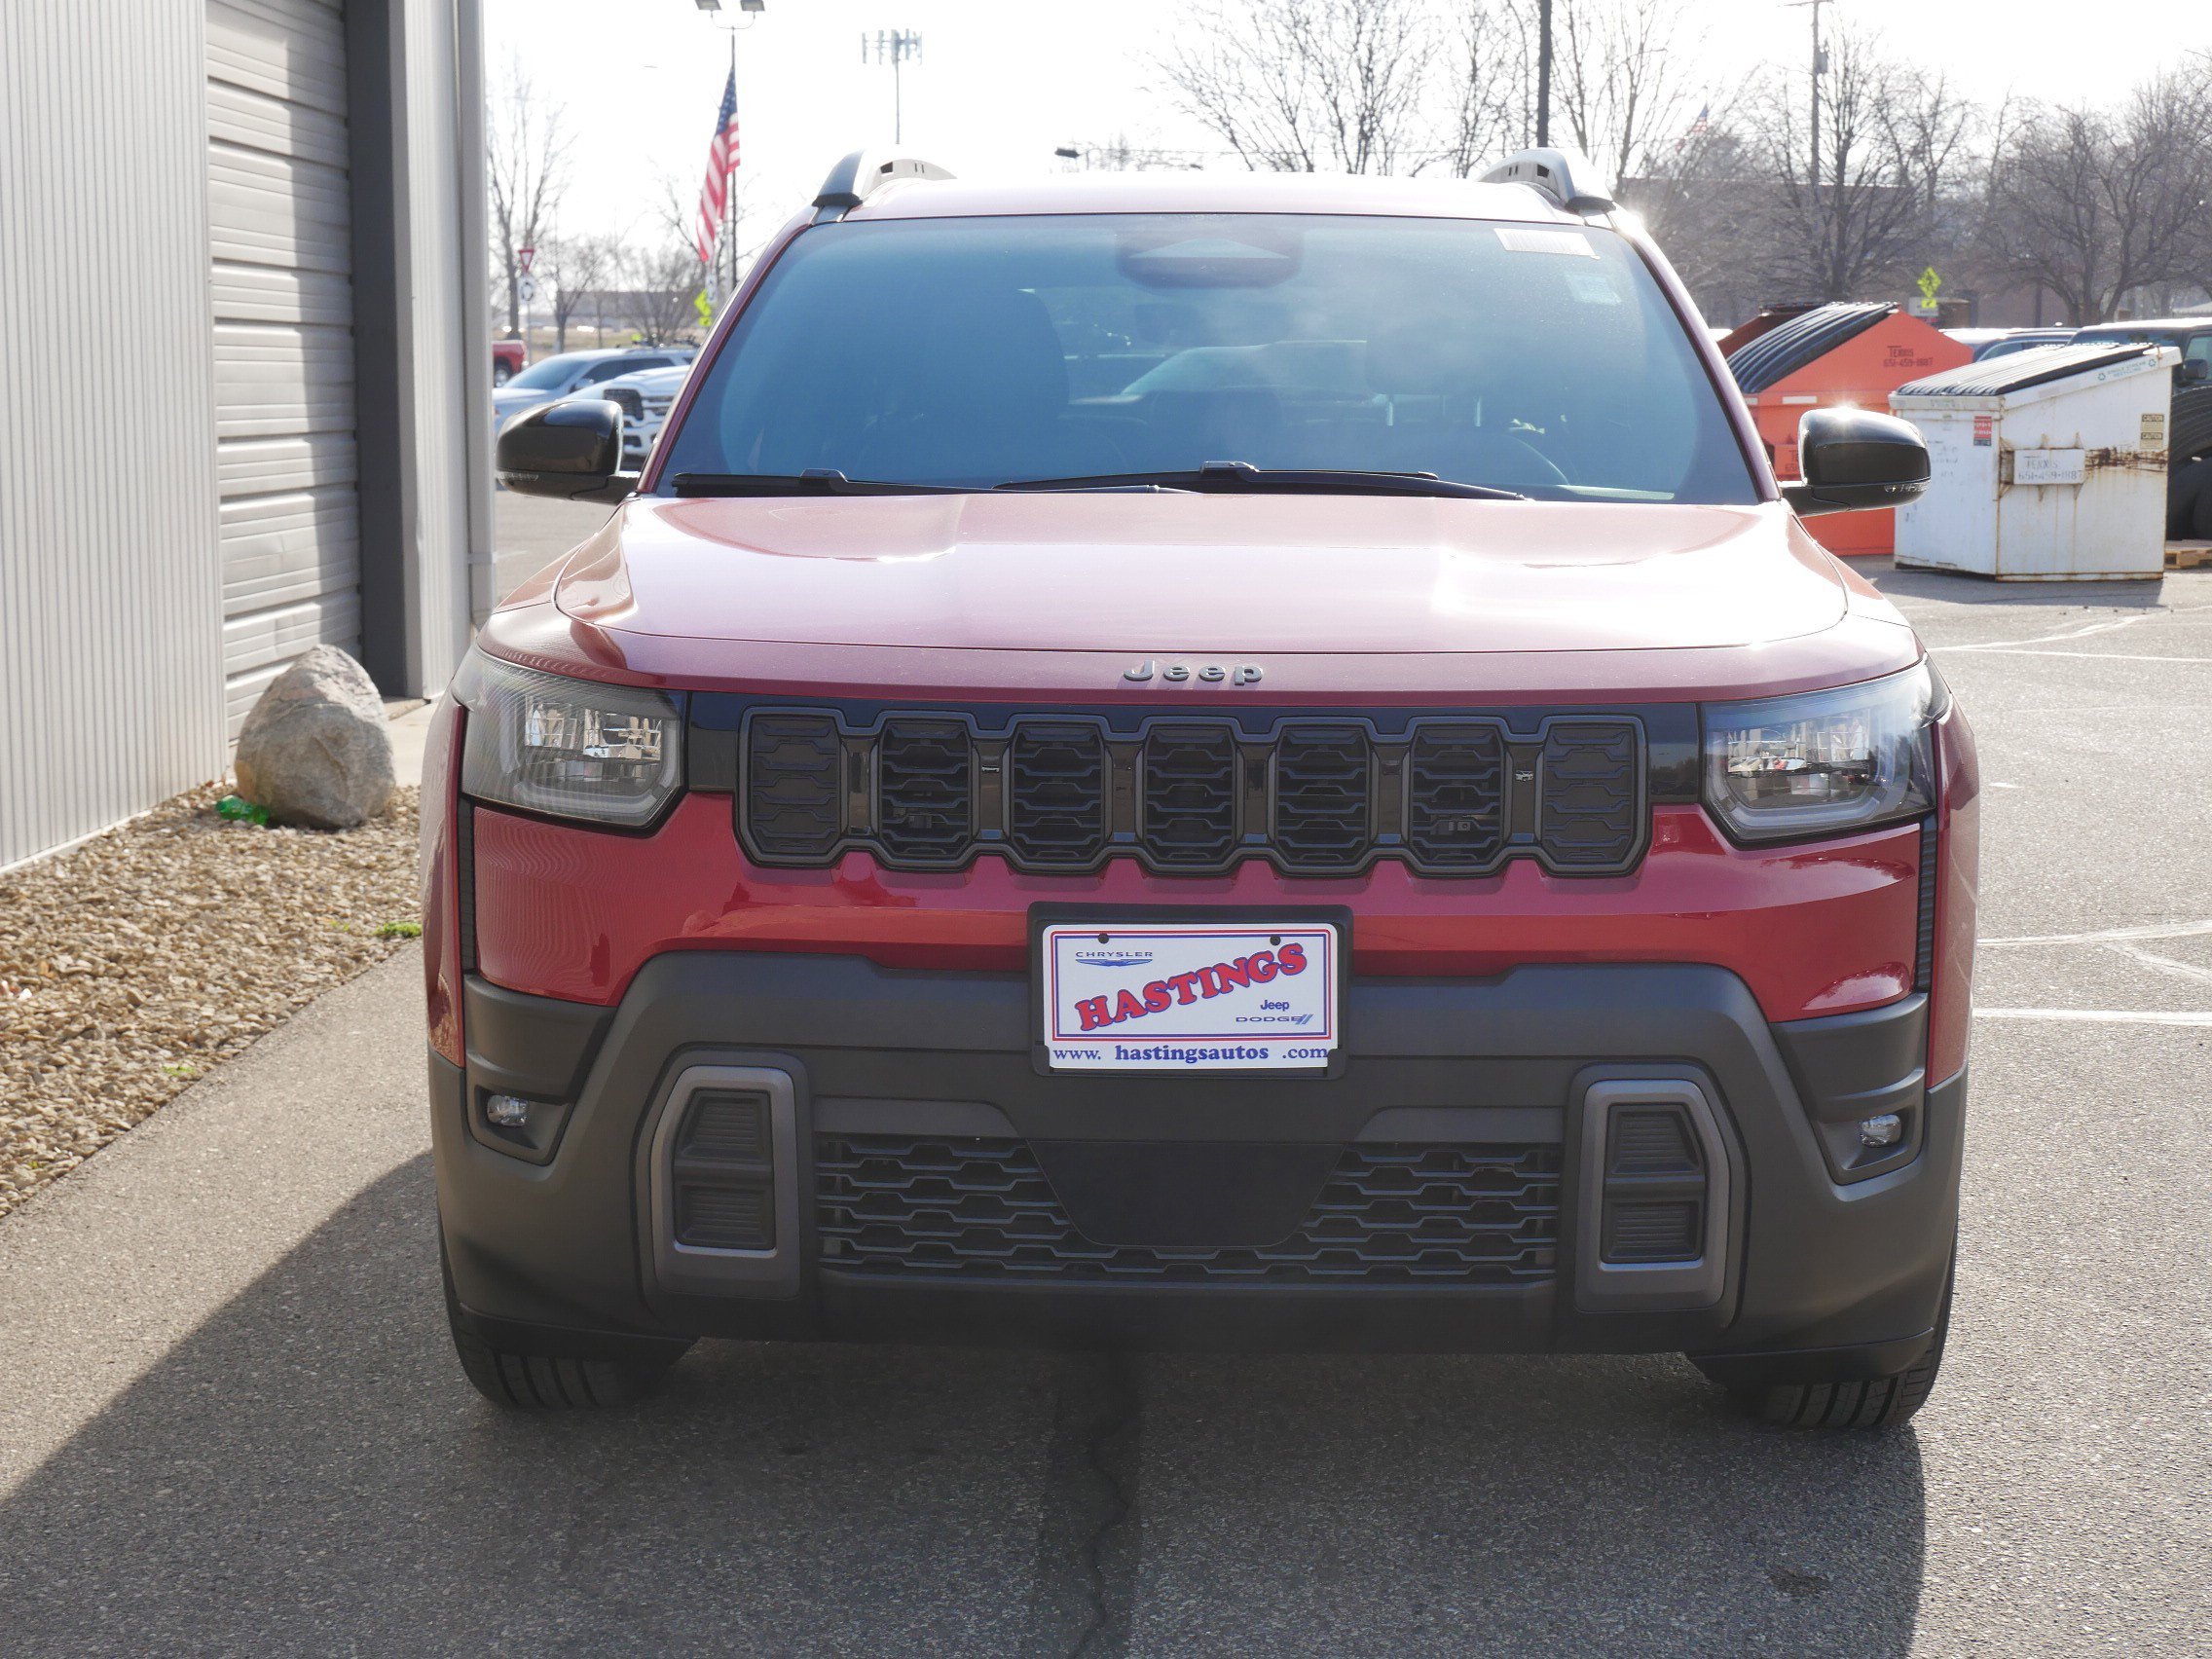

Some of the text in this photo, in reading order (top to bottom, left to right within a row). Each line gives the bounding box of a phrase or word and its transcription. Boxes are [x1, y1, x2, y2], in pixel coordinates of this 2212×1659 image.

[1123, 658, 1264, 686] Jeep
[1075, 942, 1308, 1032] HASTINGS
[1260, 999, 1290, 1012] Jeep
[1052, 1045, 1328, 1064] www. hastingsautos .com
